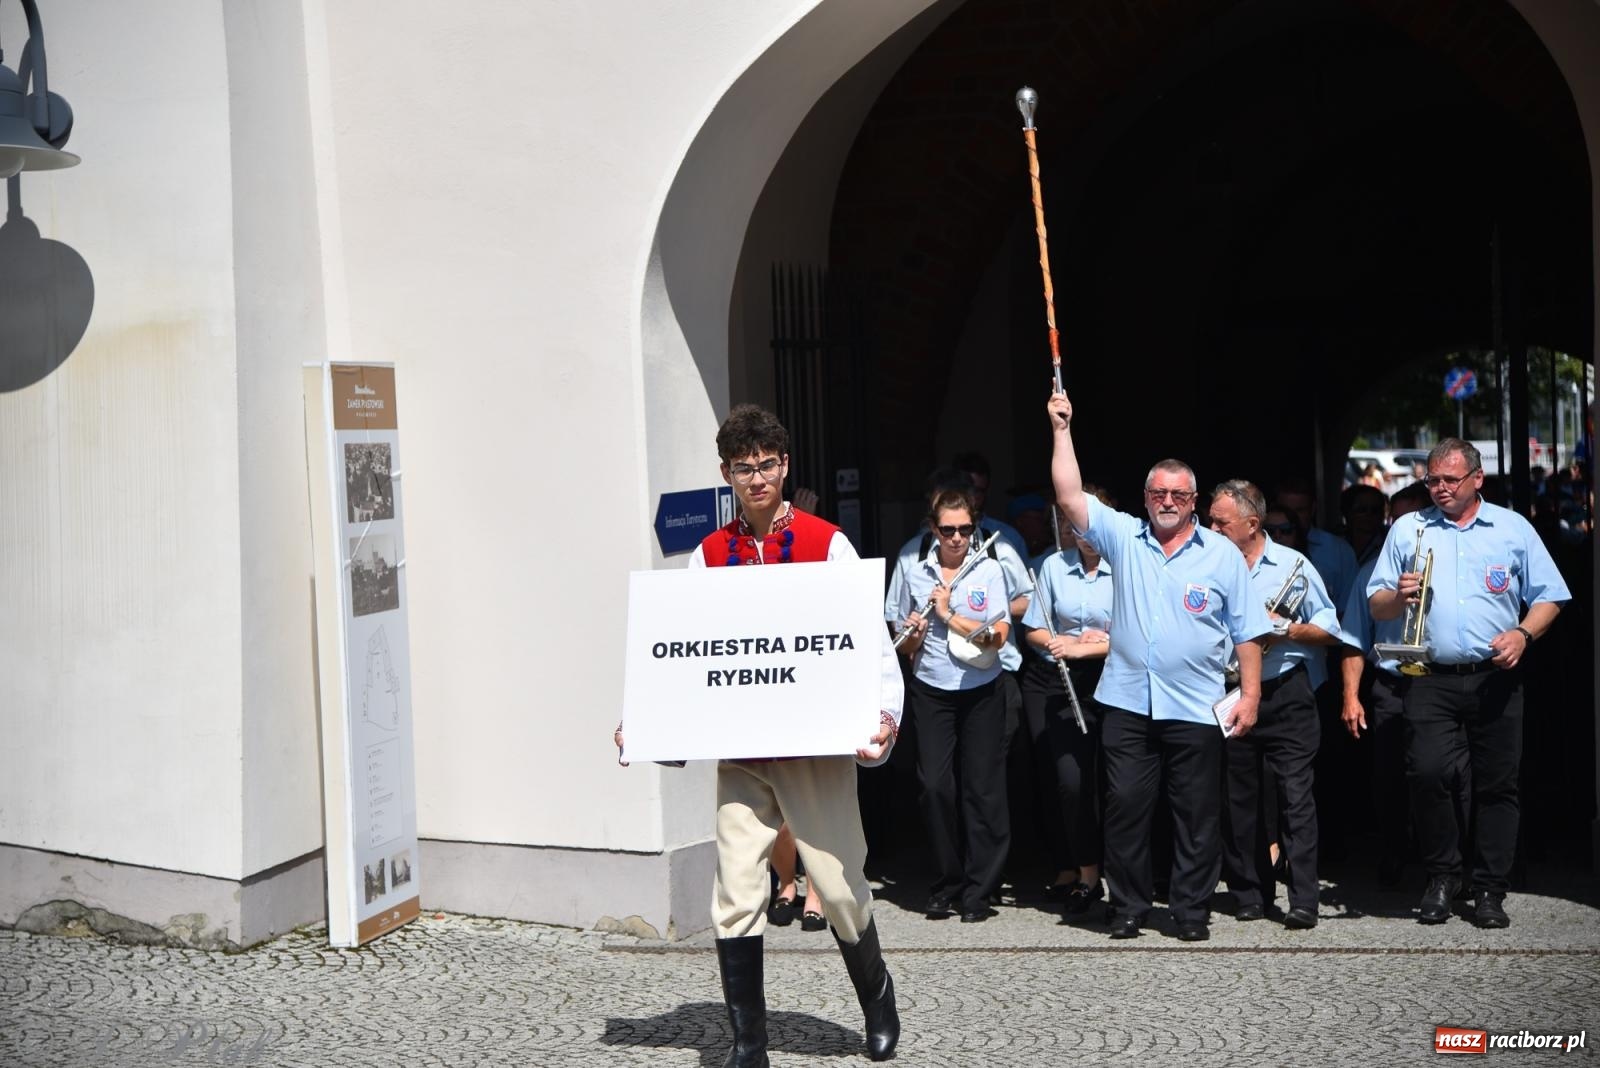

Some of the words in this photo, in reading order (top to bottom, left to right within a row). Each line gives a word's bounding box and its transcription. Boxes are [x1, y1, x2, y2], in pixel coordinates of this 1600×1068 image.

[652, 636, 786, 659] ORKIESTRA
[794, 633, 855, 656] DĘTA
[707, 666, 796, 687] RYBNIK
